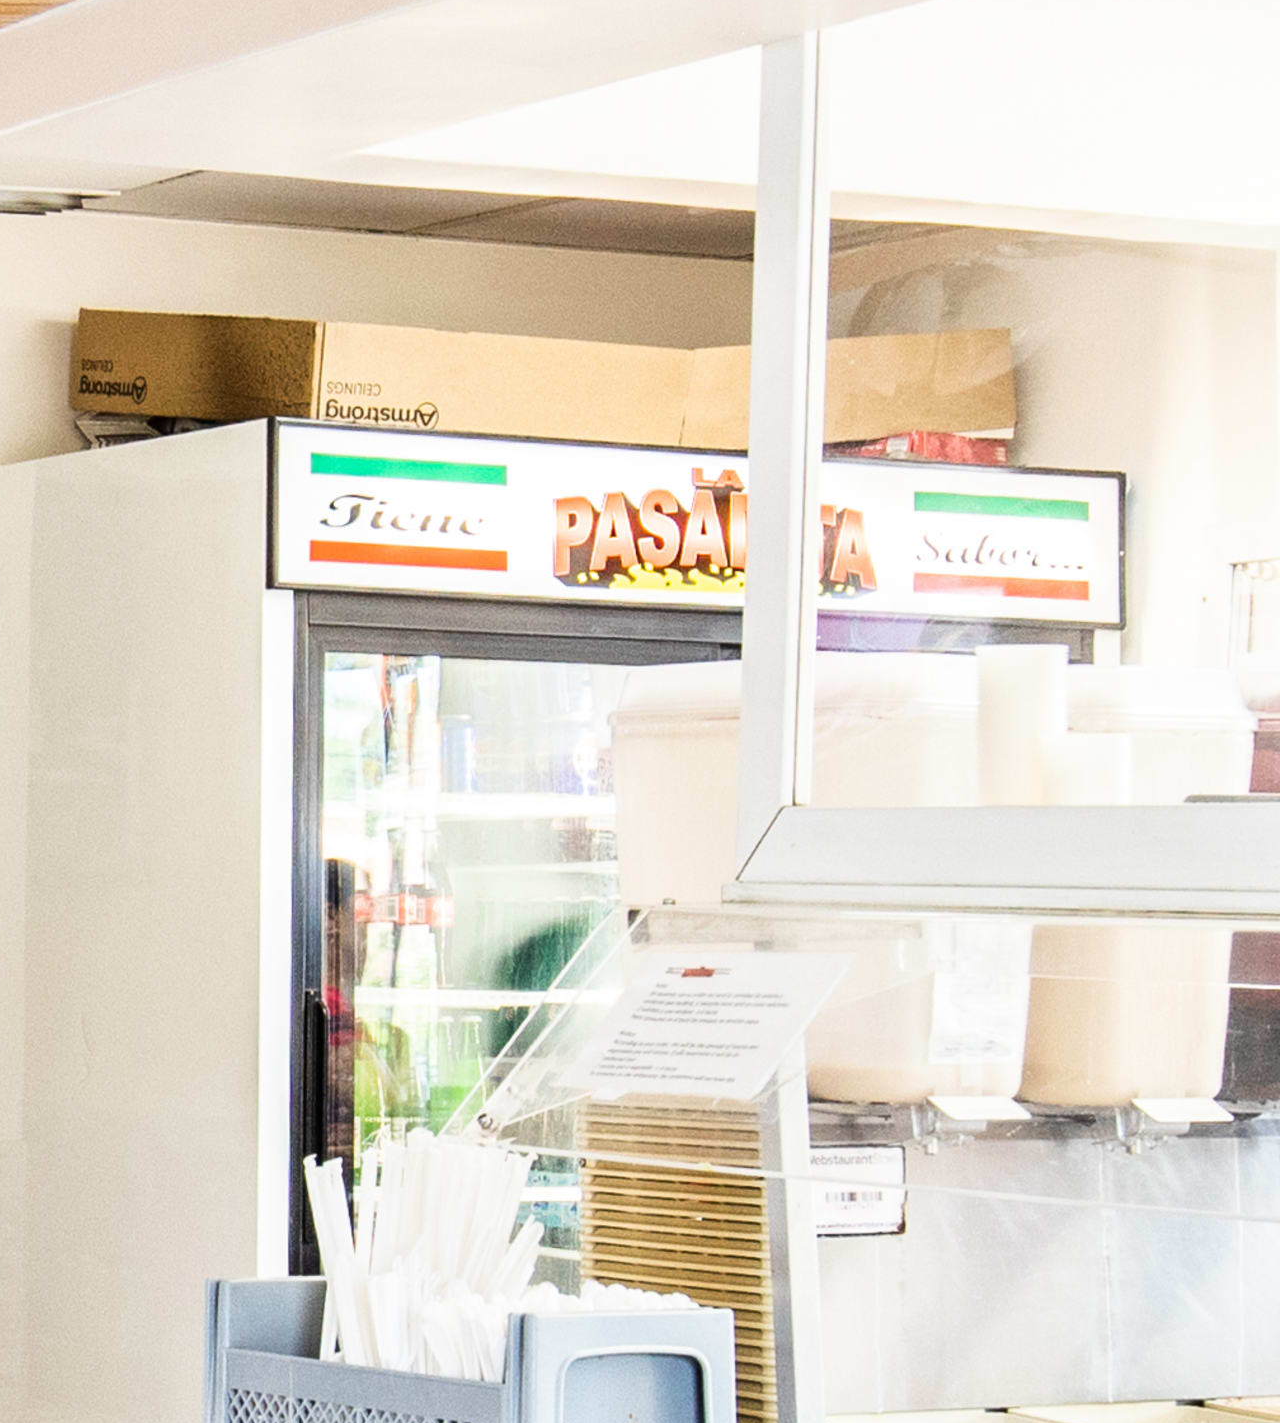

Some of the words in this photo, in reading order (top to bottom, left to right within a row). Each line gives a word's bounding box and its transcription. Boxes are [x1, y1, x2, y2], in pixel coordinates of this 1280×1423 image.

[78, 374, 148, 405] Armstrong
[326, 380, 382, 395] CEILINGS
[325, 398, 440, 429] Armstrong
[692, 467, 745, 489] LA
